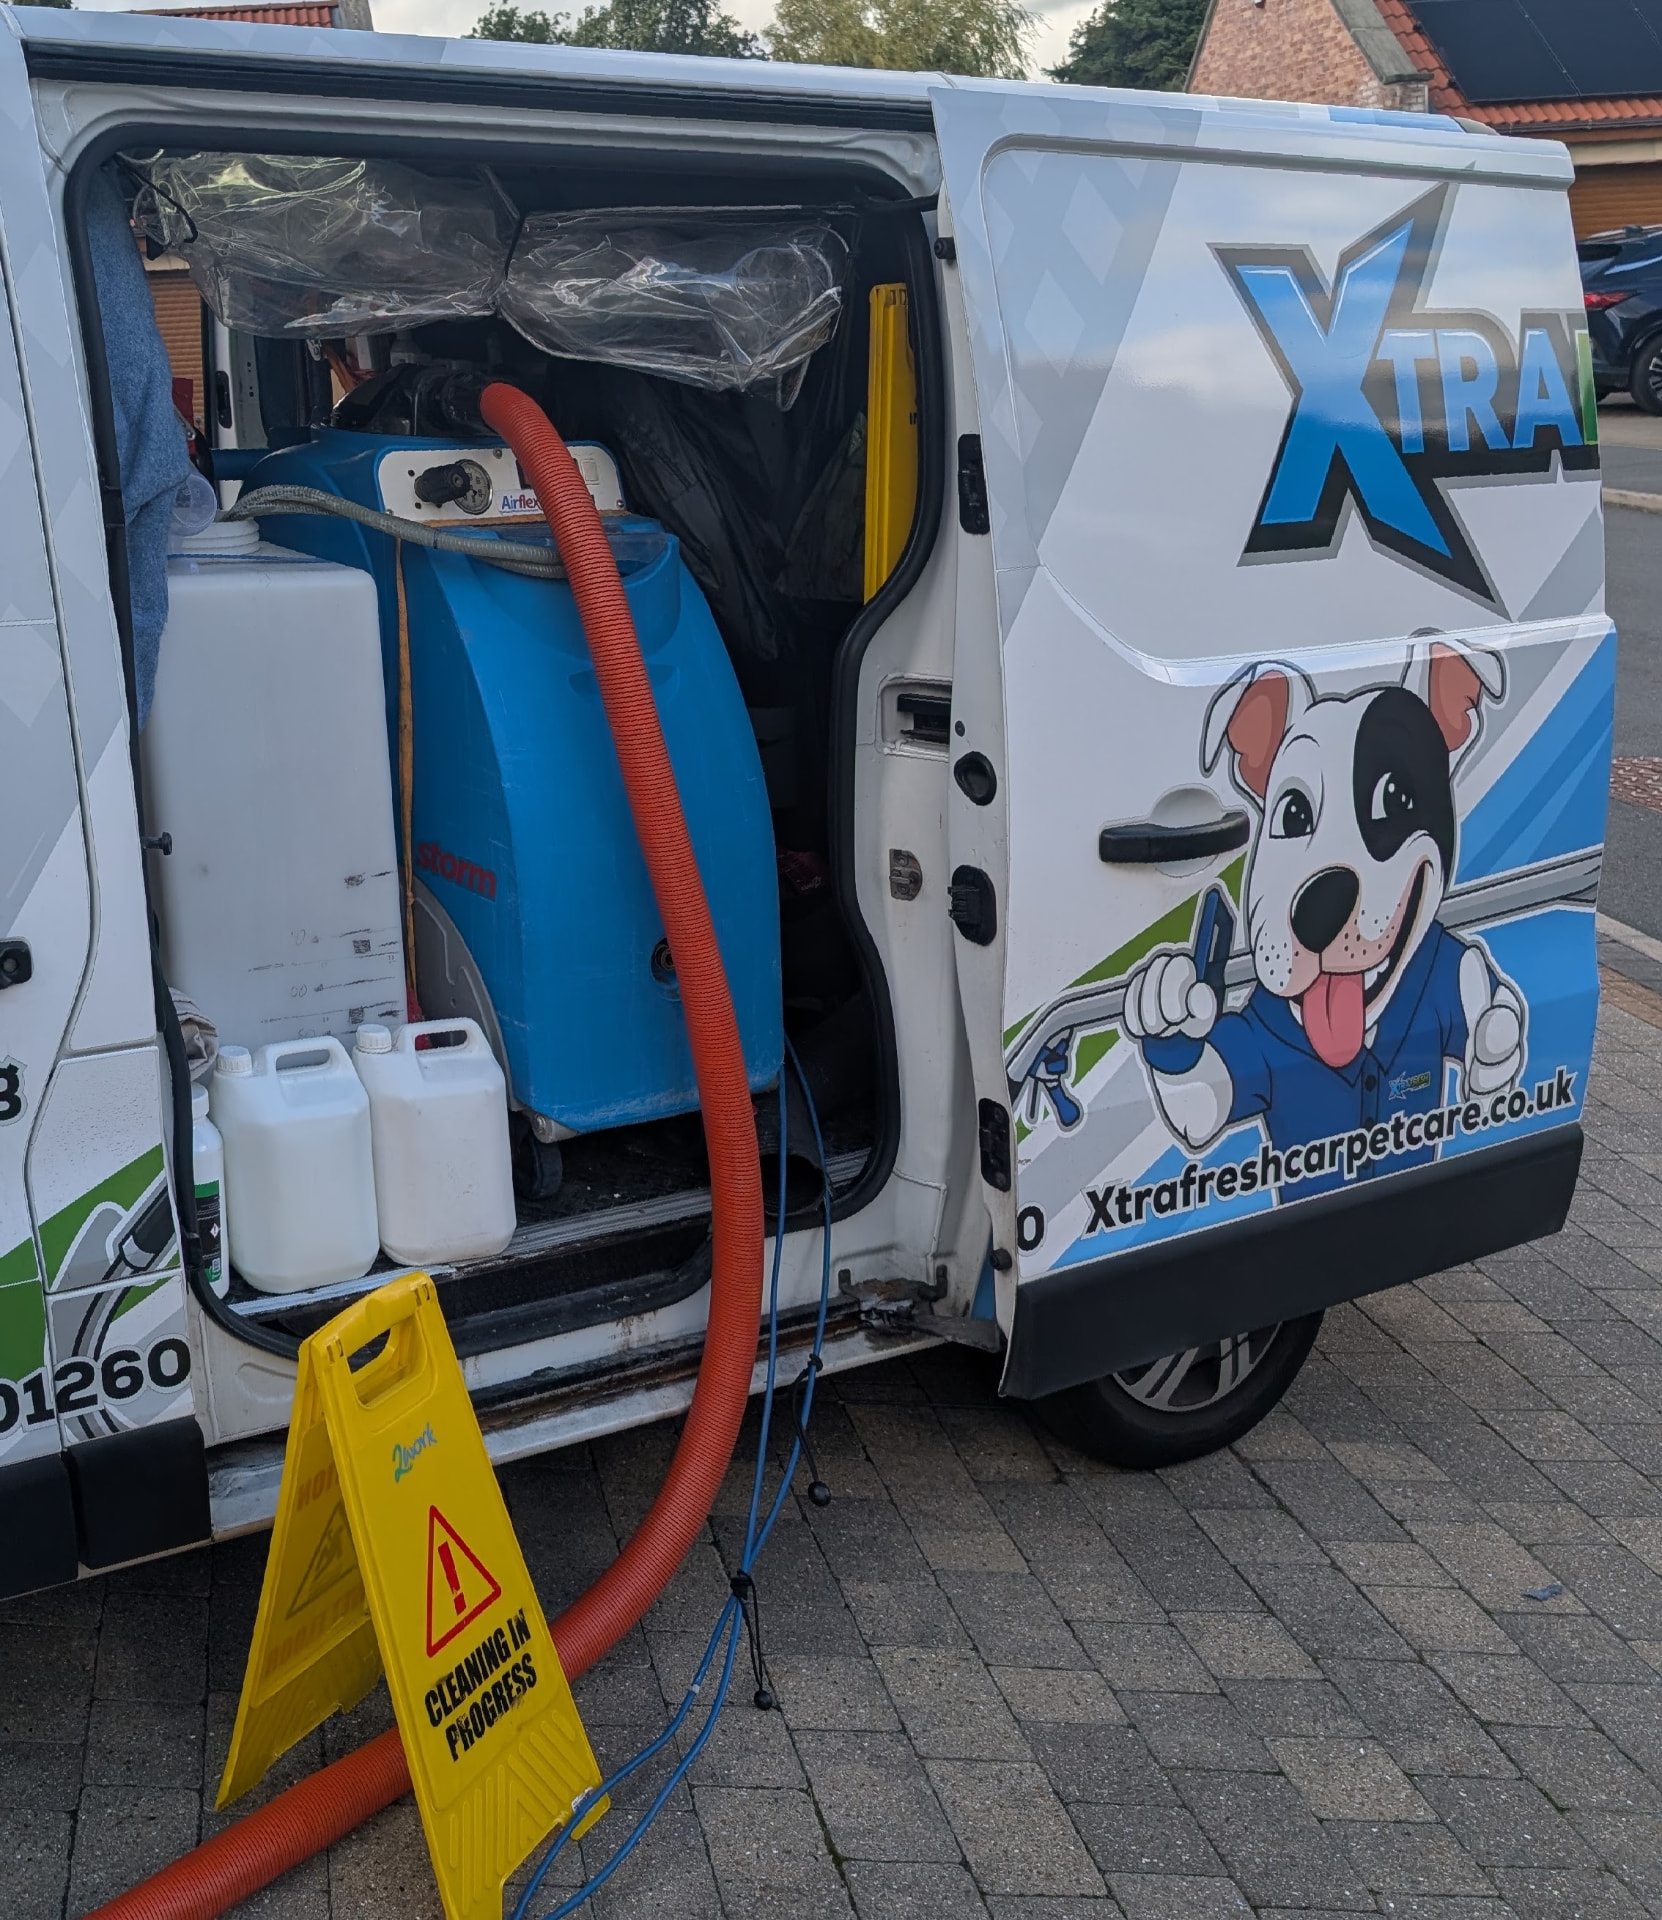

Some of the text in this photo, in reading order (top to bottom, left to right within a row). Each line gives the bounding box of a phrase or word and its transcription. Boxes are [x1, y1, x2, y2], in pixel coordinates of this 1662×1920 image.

[501, 495, 543, 511] Airflex
[418, 842, 497, 899] storm
[1085, 1069, 1575, 1235] Xtrafreshcarpetcare.co.uk
[392, 1422, 438, 1483] 2work
[424, 1627, 512, 1728] CLEANING
[506, 1608, 532, 1651] IN
[445, 1652, 537, 1762] PROGRESS
